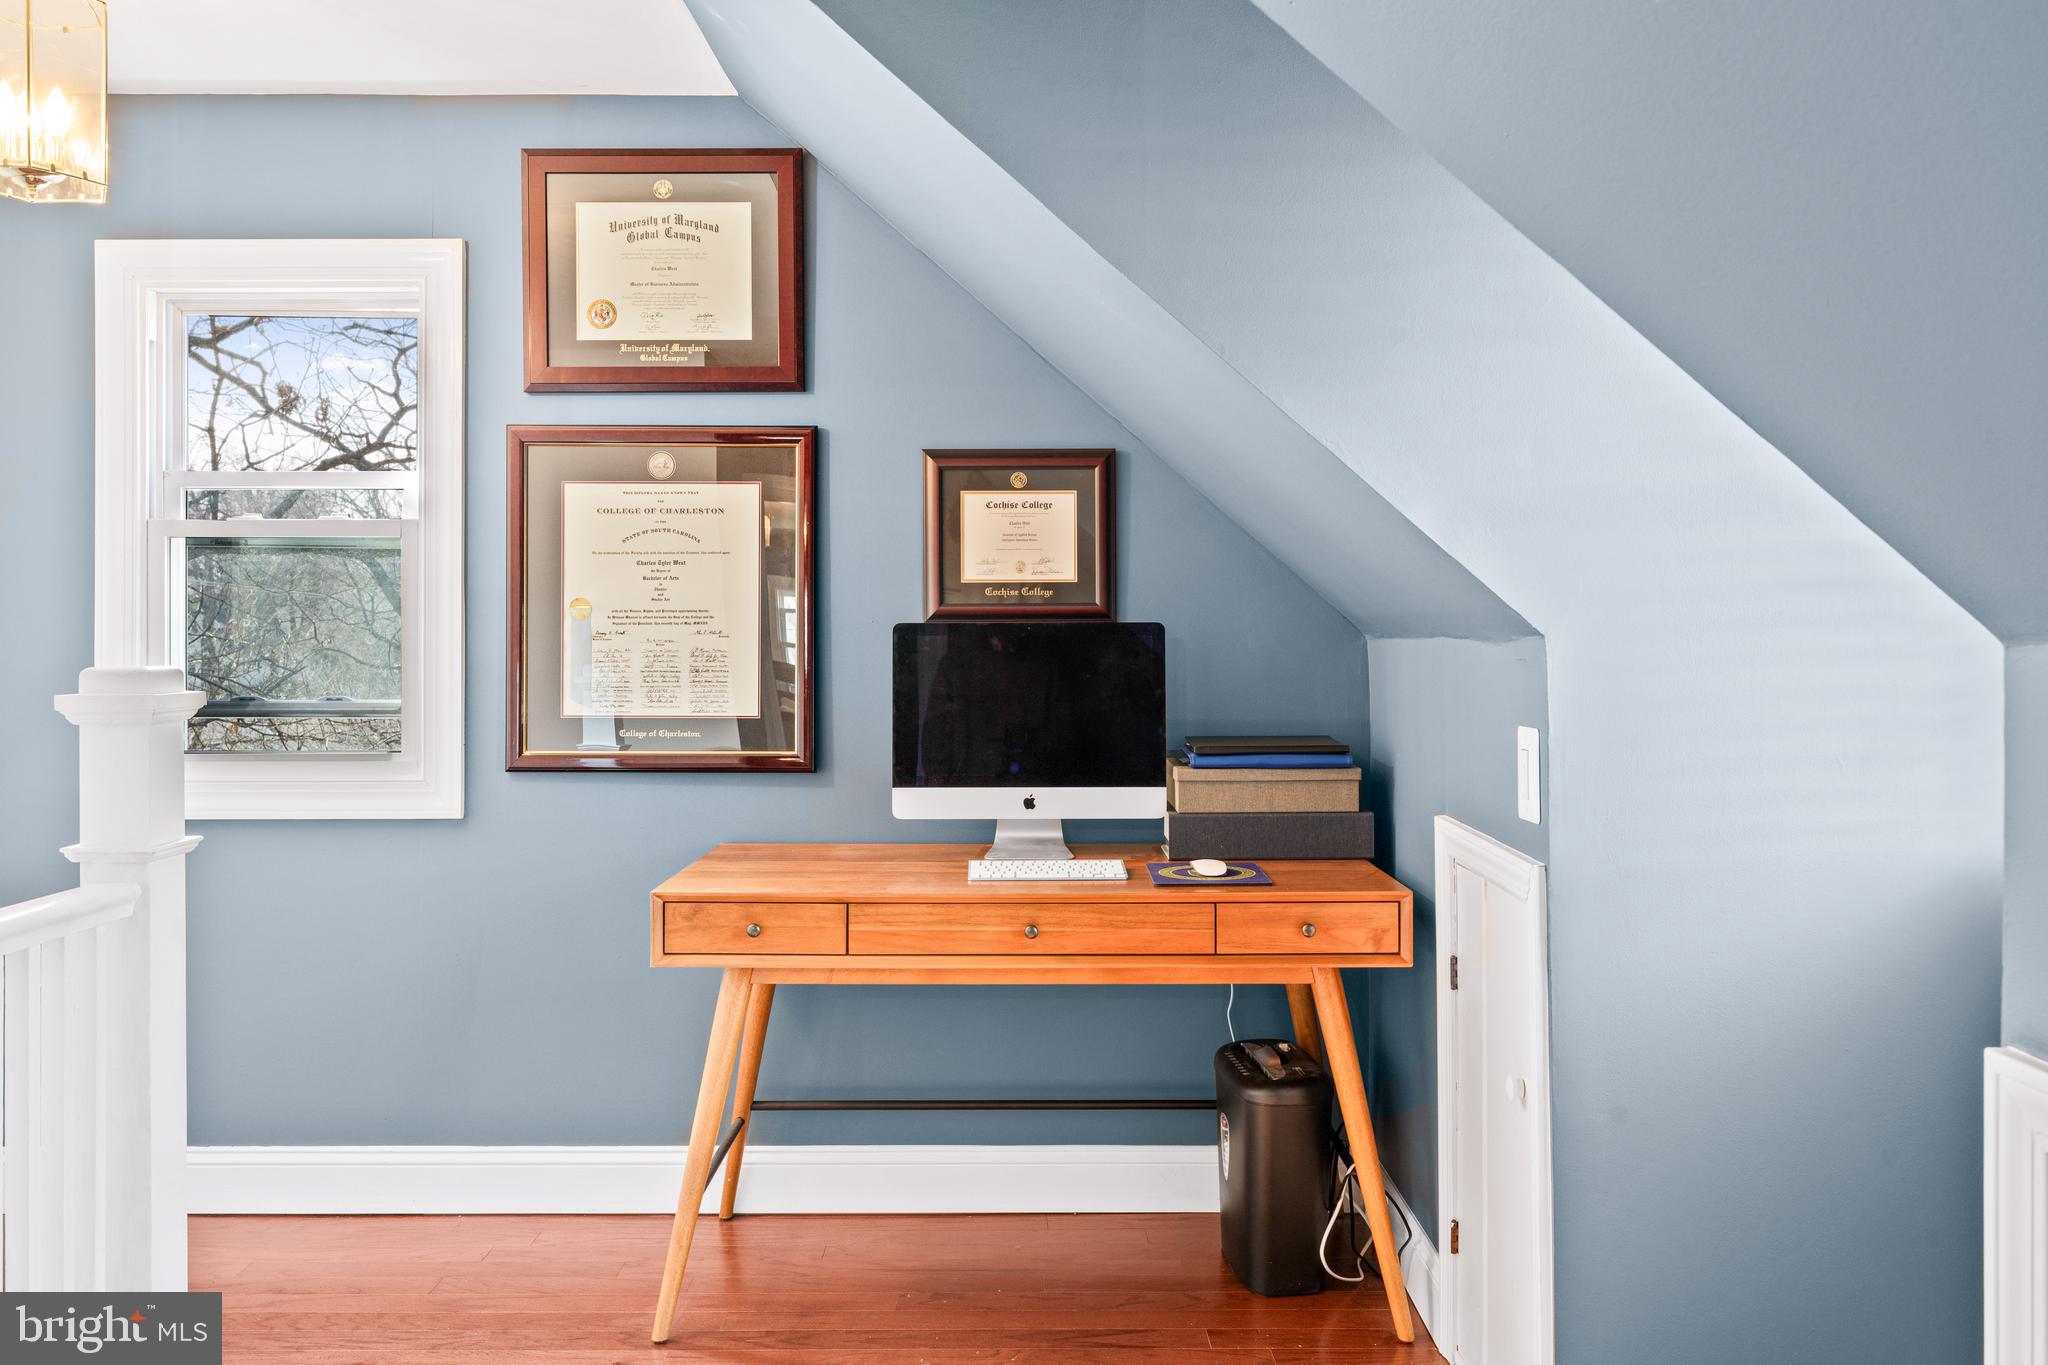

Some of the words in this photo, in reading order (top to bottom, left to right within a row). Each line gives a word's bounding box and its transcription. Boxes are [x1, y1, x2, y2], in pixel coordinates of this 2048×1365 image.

[609, 216, 658, 233] University
[661, 214, 671, 225] of
[674, 213, 720, 233] Maryland
[626, 229, 659, 243] Global
[664, 226, 701, 243] Campus
[619, 344, 661, 354] University
[661, 344, 669, 353] of
[639, 354, 662, 362] Global
[662, 354, 689, 363] Campus
[985, 501, 1019, 510] Cochise
[1021, 501, 1053, 510] College
[622, 531, 641, 543] STATE
[672, 529, 701, 543] CAROLINA
[984, 586, 1019, 598] Cochise
[1021, 586, 1054, 598] College
[619, 729, 647, 739] College
[648, 729, 657, 737] of
